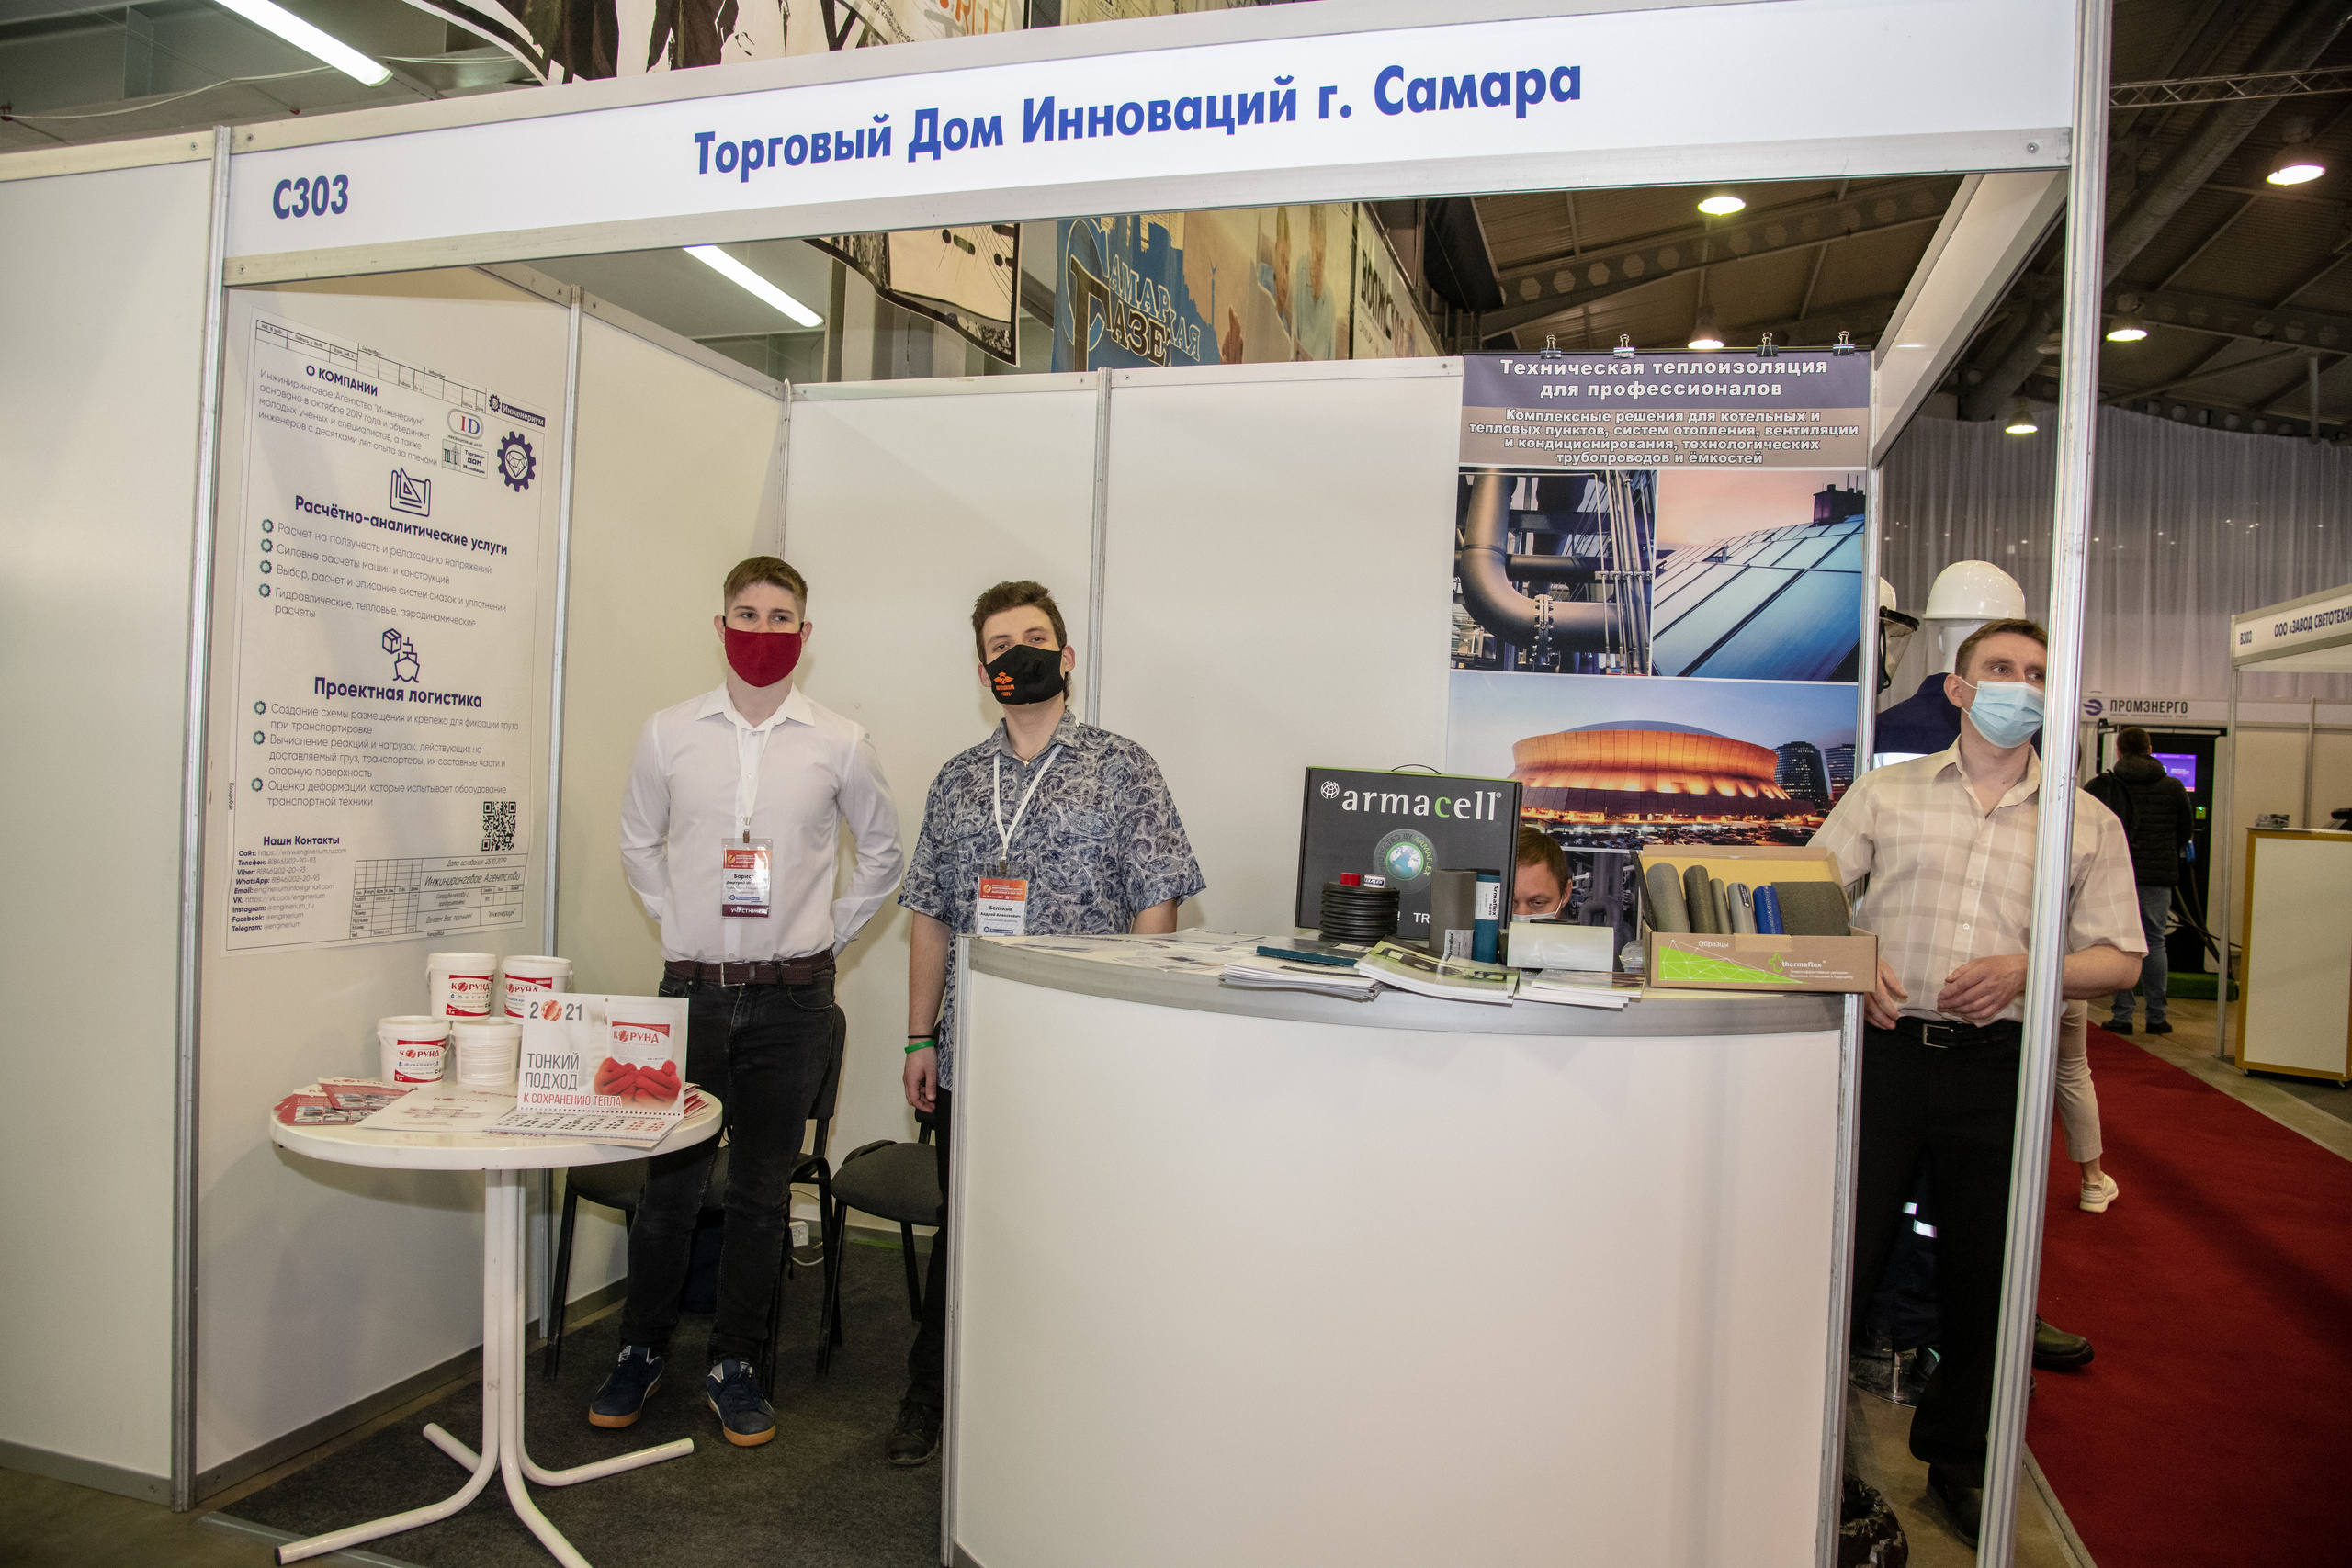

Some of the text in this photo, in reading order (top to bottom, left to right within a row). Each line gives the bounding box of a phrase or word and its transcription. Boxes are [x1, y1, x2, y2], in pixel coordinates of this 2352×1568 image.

[694, 64, 1581, 182] Торговый Дом Инноваций г. Самара
[273, 174, 349, 220] С303
[1499, 356, 1828, 378] Техническая теплоизоляция
[305, 364, 378, 397] О КОМПАНИИ
[1539, 379, 1782, 400] для профессионалов
[260, 368, 424, 425] Инжиниринговое Агентство "Инженериум"
[259, 384, 303, 403] основано
[303, 397, 309, 405] в
[311, 399, 345, 415] октябре
[345, 407, 363, 420] 2019
[364, 414, 381, 426] года
[389, 423, 430, 440] объединяет
[503, 404, 545, 426] Инженериум
[1504, 407, 1822, 424] Комплексные решения для котельных и
[258, 398, 297, 414] молодых
[298, 409, 329, 423] ученых
[336, 420, 393, 444] специалистов,
[401, 437, 422, 450] также
[1466, 421, 1860, 439] тепловых пунктов, систем отопления, вентиляции
[258, 412, 307, 431] инженеров
[307, 424, 313, 433] с
[314, 426, 357, 444] десятками
[358, 438, 372, 447] лет
[373, 443, 396, 455] опыта
[397, 449, 406, 457] за
[407, 452, 437, 466] плечами
[1502, 435, 1822, 454] и кондиционирования, технологических
[1555, 450, 1764, 467] трубопроводов и ёмкостей
[295, 494, 507, 556] Расчётно-аналитические услуги
[277, 522, 492, 574] Расчет на ползучесть и релаксацию напряжений
[276, 543, 320, 561] Силовые
[321, 554, 360, 569] расчеты
[362, 561, 391, 573] машин
[400, 569, 450, 584] конструкций
[276, 563, 311, 581] Выбор,
[311, 572, 345, 585] расчет
[346, 578, 353, 586] и
[355, 580, 397, 594] описание
[398, 587, 428, 599] систем
[428, 592, 457, 604] смазок
[465, 599, 506, 612] уплотнений
[274, 604, 316, 618] расчеты
[275, 586, 476, 627] Гидравлические, тепловые, аэродинамические
[2274, 622, 2288, 637] ООО
[2289, 615, 2312, 633] «ЗАВОД
[314, 676, 482, 708] Проектная логистика
[270, 703, 319, 716] Создание
[320, 708, 349, 718] схемы
[350, 711, 405, 722] размещения
[413, 716, 448, 726] крепежа
[449, 718, 463, 727] для
[464, 717, 500, 729] фиксации
[500, 721, 519, 731] груза
[2109, 699, 2188, 714] ПРОМЭНЕРГО
[270, 720, 373, 735] при транспортировке
[269, 733, 329, 747] Вычисление
[330, 739, 369, 750] реакций
[378, 741, 419, 753] нагрузок,
[419, 742, 471, 754] действующих
[472, 746, 482, 754] на
[268, 751, 337, 762] доставляемый
[339, 754, 361, 765] груз,
[362, 755, 426, 767] транспортеры,
[437, 758, 478, 767] составные
[479, 760, 500, 768] части
[268, 766, 372, 779] опорную поверхность
[267, 779, 507, 795] Оценка деформаций, которые испытывает оборудование
[266, 797, 373, 808] транспортной техники
[263, 835, 340, 846] Наши Контакты
[1403, 832, 1413, 840] BY
[1413, 836, 1433, 877] ARMAFLEX
[424, 871, 521, 886] Инжиниринговое Агентство
[1698, 940, 1729, 948] Образцы
[527, 1052, 580, 1071] ТОНКИЙ
[525, 1072, 578, 1091] ПОДХОД
[524, 1092, 622, 1107] К СОХРАНЕНИЮ ТЕПЛА
